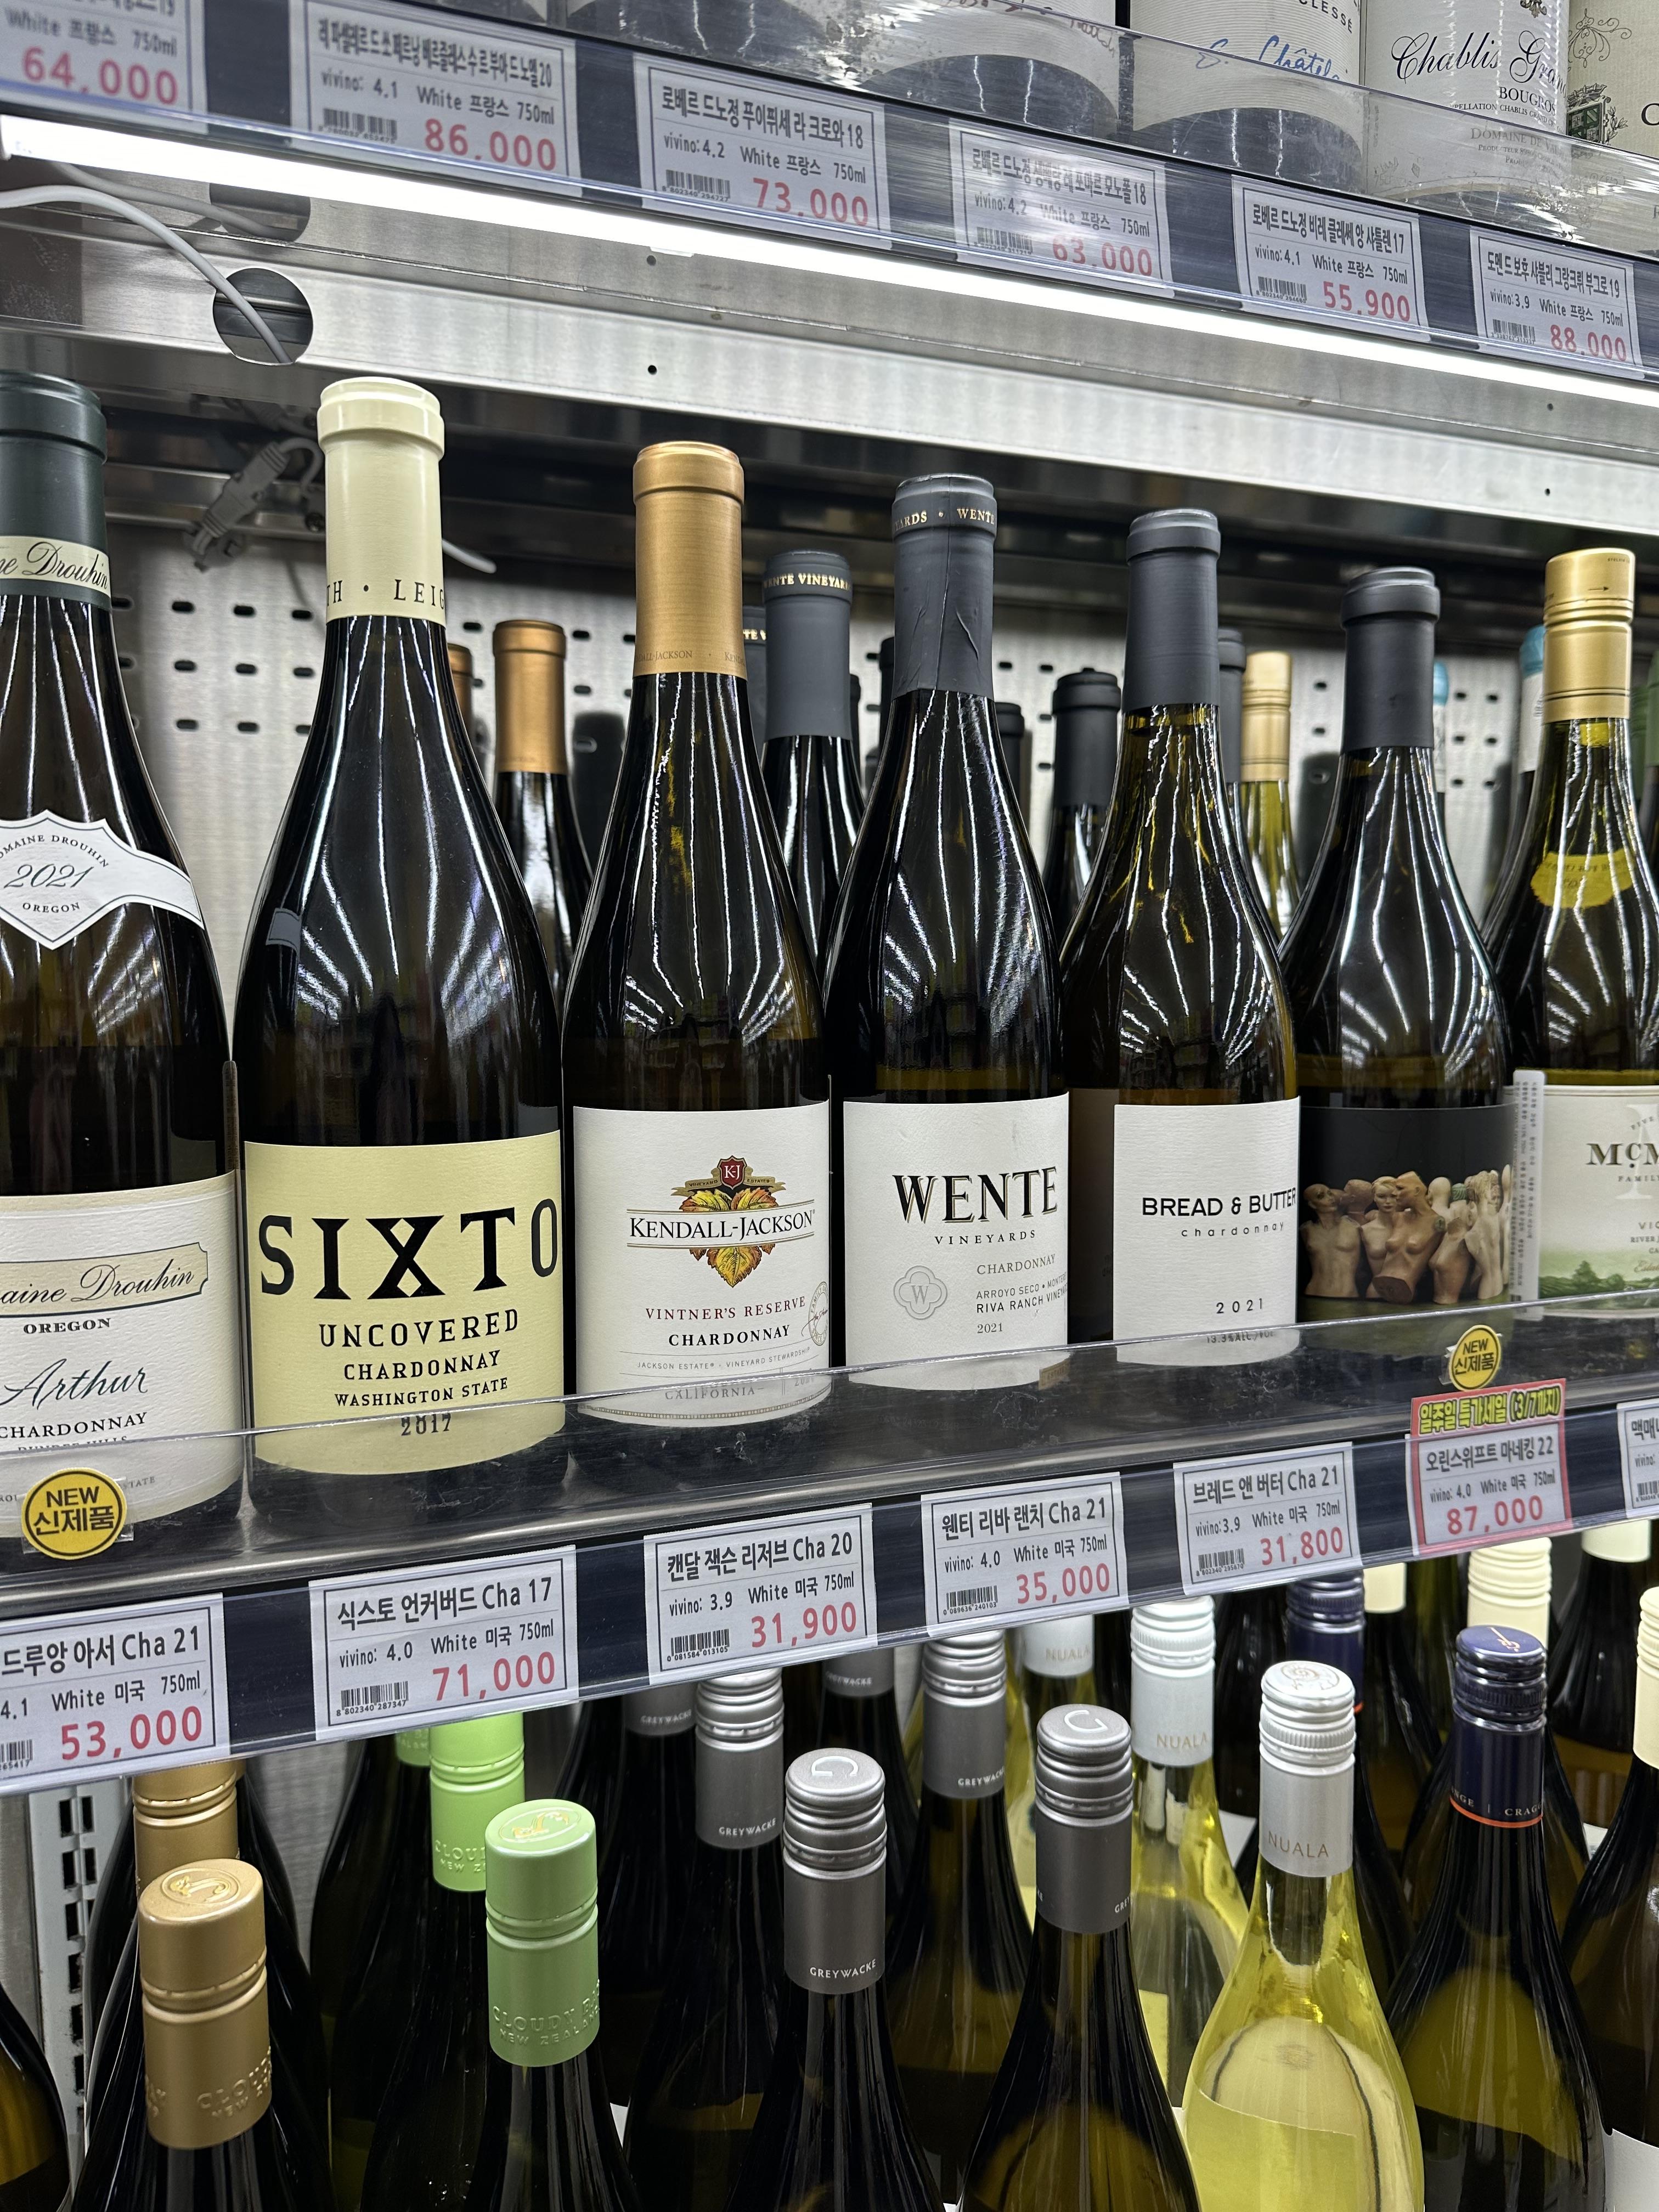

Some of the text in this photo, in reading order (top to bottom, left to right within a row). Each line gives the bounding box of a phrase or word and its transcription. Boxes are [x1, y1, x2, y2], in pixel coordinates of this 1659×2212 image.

[1391, 32, 1500, 84] Chablis
[373, 78, 555, 125] 4.1 White 프랑스 750ml
[1499, 87, 1556, 116] BOUGROS
[1500, 104, 1527, 115] CHABLIS
[662, 86, 700, 117] 로베르
[702, 94, 739, 128] 드노정
[809, 115, 844, 148] 크로와
[848, 123, 863, 149] 18
[740, 145, 866, 184] White 프랑스 750ml
[1133, 182, 1147, 206] 18
[1081, 211, 1150, 238] 프랑스 750ml
[1253, 204, 1279, 231] 로베르
[1281, 210, 1307, 238] 드노정
[1309, 215, 1327, 242] 비레
[1355, 224, 1364, 249] 앙
[1393, 233, 1404, 254] 17
[1312, 254, 1408, 285] White 프랑스 750ml
[1487, 251, 1503, 276] 도멘
[1504, 256, 1513, 275] 드
[1586, 272, 1609, 296] 부그로
[1610, 279, 1620, 298] 19
[1539, 298, 1623, 327] White 프랑스 750ml
[957, 508, 995, 525] WENTE
[22, 541, 108, 589] Drouhin
[52, 834, 109, 868] DROUHIN
[3, 864, 94, 889] 2021
[22, 902, 80, 913] OREGON
[724, 1165, 741, 1180] K-J
[892, 1166, 1057, 1224] WENTE
[1142, 1187, 1296, 1216] BREAD & BUTTER
[629, 1210, 812, 1240] KENDALL-JACKSON
[935, 1231, 1035, 1245] VINEYARDS
[1181, 1221, 1284, 1237] chardonnay
[259, 1199, 558, 1300] SIXTO
[977, 1254, 1056, 1275] CHARDONNAY
[71, 1259, 195, 1302] Drouhin
[911, 1285, 928, 1304] W
[977, 1284, 1039, 1299] ARROYO SECO
[744, 1296, 806, 1317] RESERVE
[977, 1295, 1043, 1313] RIVA RANCH
[1216, 1299, 1263, 1314] 2021
[23, 1318, 111, 1334] OREGON
[319, 1309, 518, 1348] UNCOVERED
[668, 1325, 790, 1346] CHARDONNAY
[977, 1323, 1003, 1334] 2021
[726, 1358, 766, 1368] VINEYARD
[769, 1347, 810, 1364] STEWARDSHIP
[1463, 1338, 1488, 1355] NEW
[344, 1350, 500, 1380] CHARDONNAY
[1454, 1352, 1494, 1376] 신제품
[0, 1358, 148, 1410] Arthur
[335, 1378, 508, 1407] WASHINGTON STATE
[401, 1413, 452, 1436] 2017
[1419, 1386, 1561, 1434] 일주일 특가세일 (3/7까지)
[1426, 1436, 1554, 1473] 오린스위프트 마네킹 22
[46, 1486, 99, 1508] NEW
[1193, 1465, 1338, 1504] 브레드 앤 버터 Cha 21
[1430, 1468, 1555, 1504] vivino: 4.0 White 미국 750ml
[34, 1506, 115, 1536] 신제품
[942, 1497, 1105, 1541] 웬티 리바 랜치 Cha 21
[1252, 1499, 1340, 1527] White 미국 750ml
[1447, 1494, 1543, 1535] 87,000
[667, 1532, 852, 1582] 캔달 잭슨 리저브 Cha 20
[944, 1534, 1107, 1573] vivino: 4.0 White 미국 750ml
[1260, 1526, 1343, 1566] 31,800
[669, 1571, 854, 1617] vivino: 3.9 White 미국 750ml
[1017, 1562, 1110, 1604] 35,000
[338, 1577, 551, 1631] 식스토 언커버드 Cha 17
[751, 1601, 856, 1648] 31,900
[1, 1626, 199, 1676] 드루앙 아서 Cha 21
[340, 1618, 554, 1668] vivino: 4.0 White 미국 750ml
[674, 1646, 728, 1661] 081584 013105
[432, 1651, 555, 1701] 71,000
[1, 1670, 201, 1719] 4.1 White 미국 750ml
[345, 1700, 407, 1716] 802340 287347
[61, 1706, 202, 1760] 53,000
[1157, 1732, 1207, 1749] NUALA
[719, 1818, 776, 1836] GREYWACKE
[1268, 1831, 1330, 1859] NUALA
[810, 1959, 876, 1979] GREYWACKE
[493, 2006, 575, 2031] CLOUDY
[500, 2028, 529, 2046] NEW
